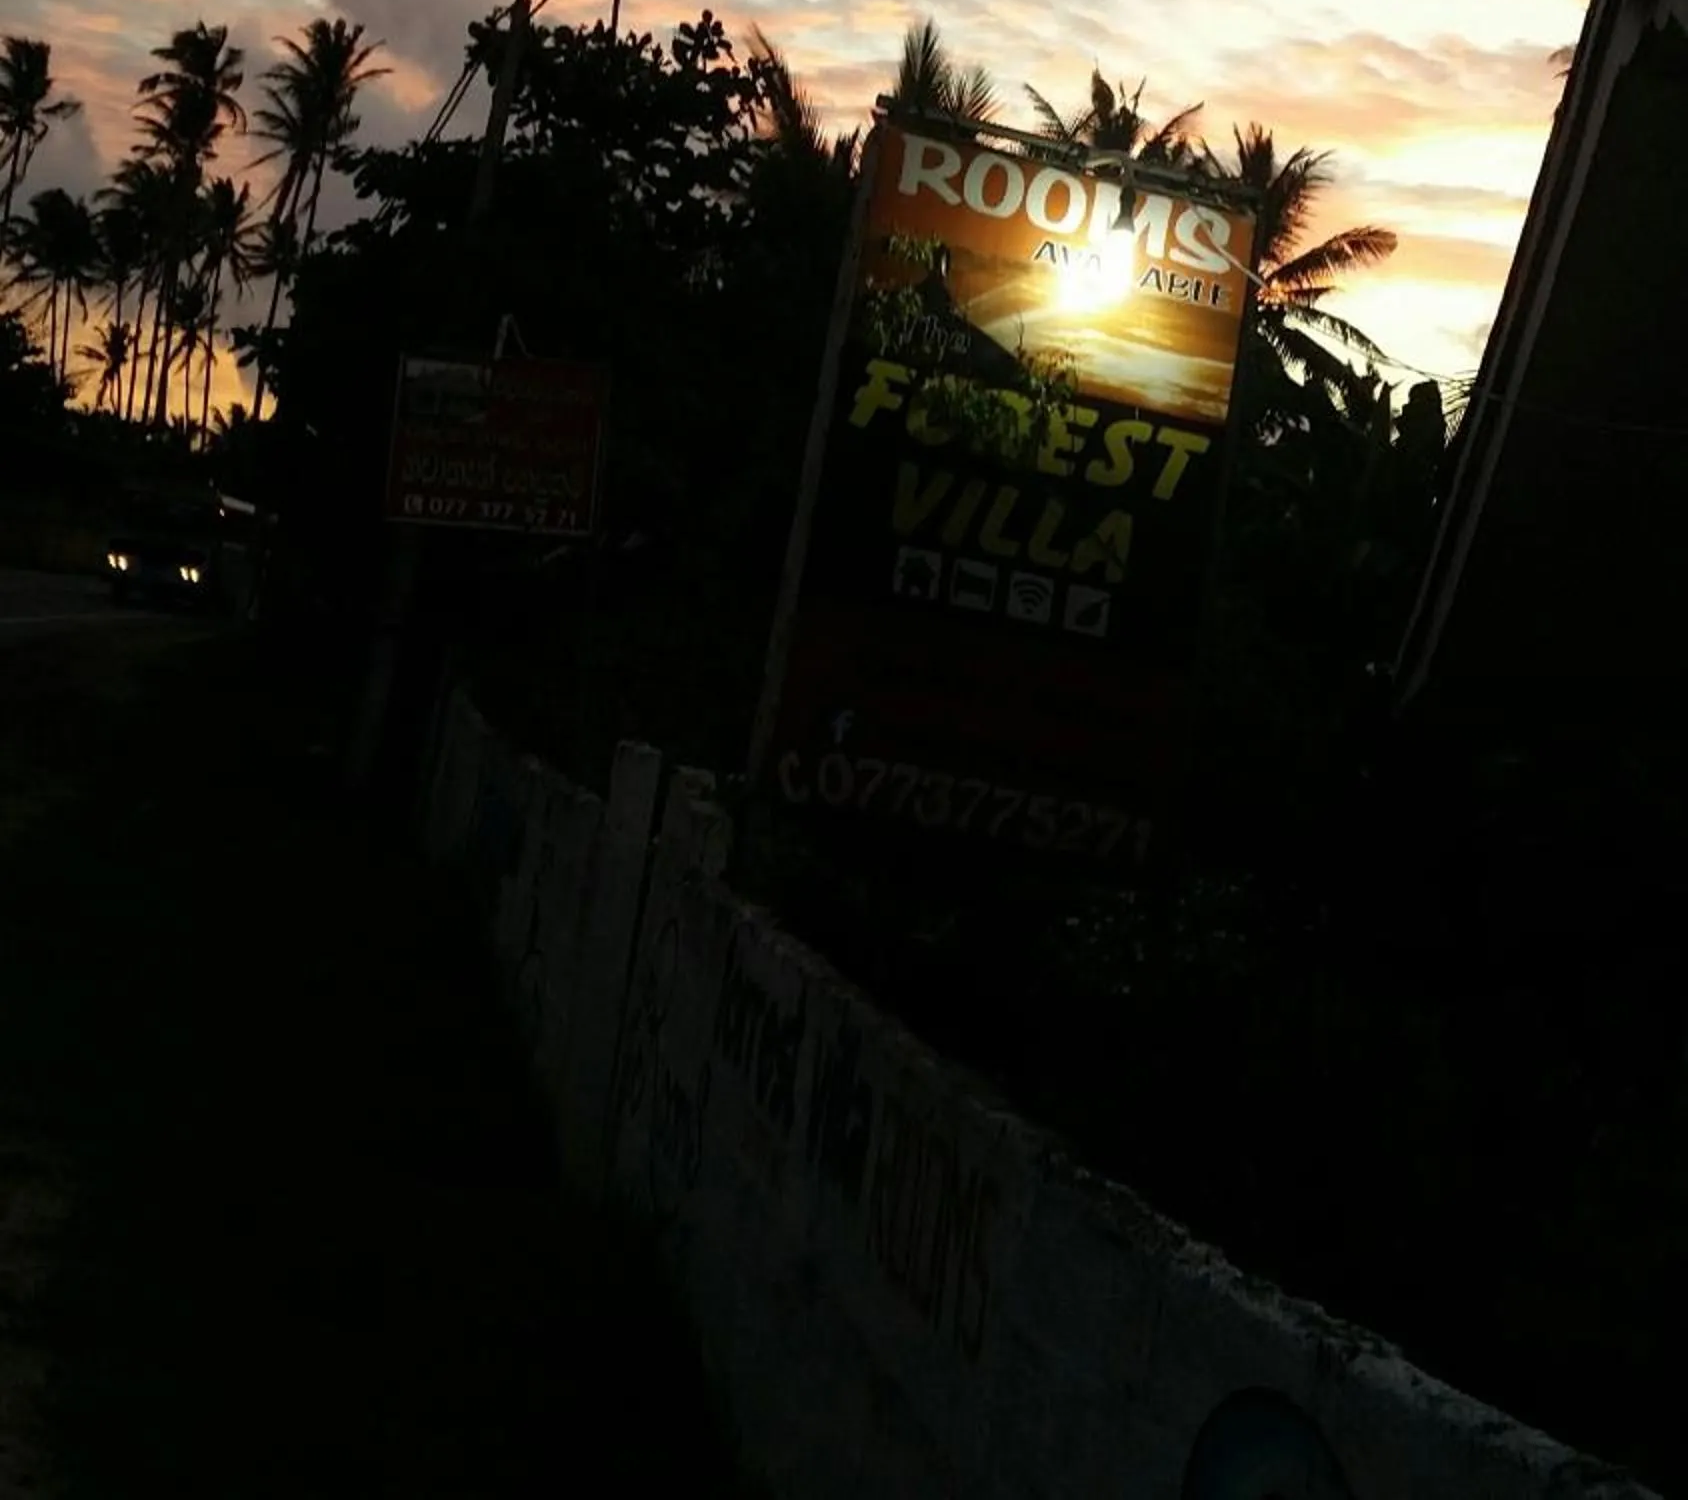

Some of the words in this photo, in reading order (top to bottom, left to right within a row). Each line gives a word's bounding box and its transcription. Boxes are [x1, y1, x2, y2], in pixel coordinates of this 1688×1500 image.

[898, 132, 1232, 275] ROOMS
[1034, 239, 1232, 313] AVAABLE
[891, 461, 1134, 584] VILLA
[817, 752, 1155, 866] 0773775271
